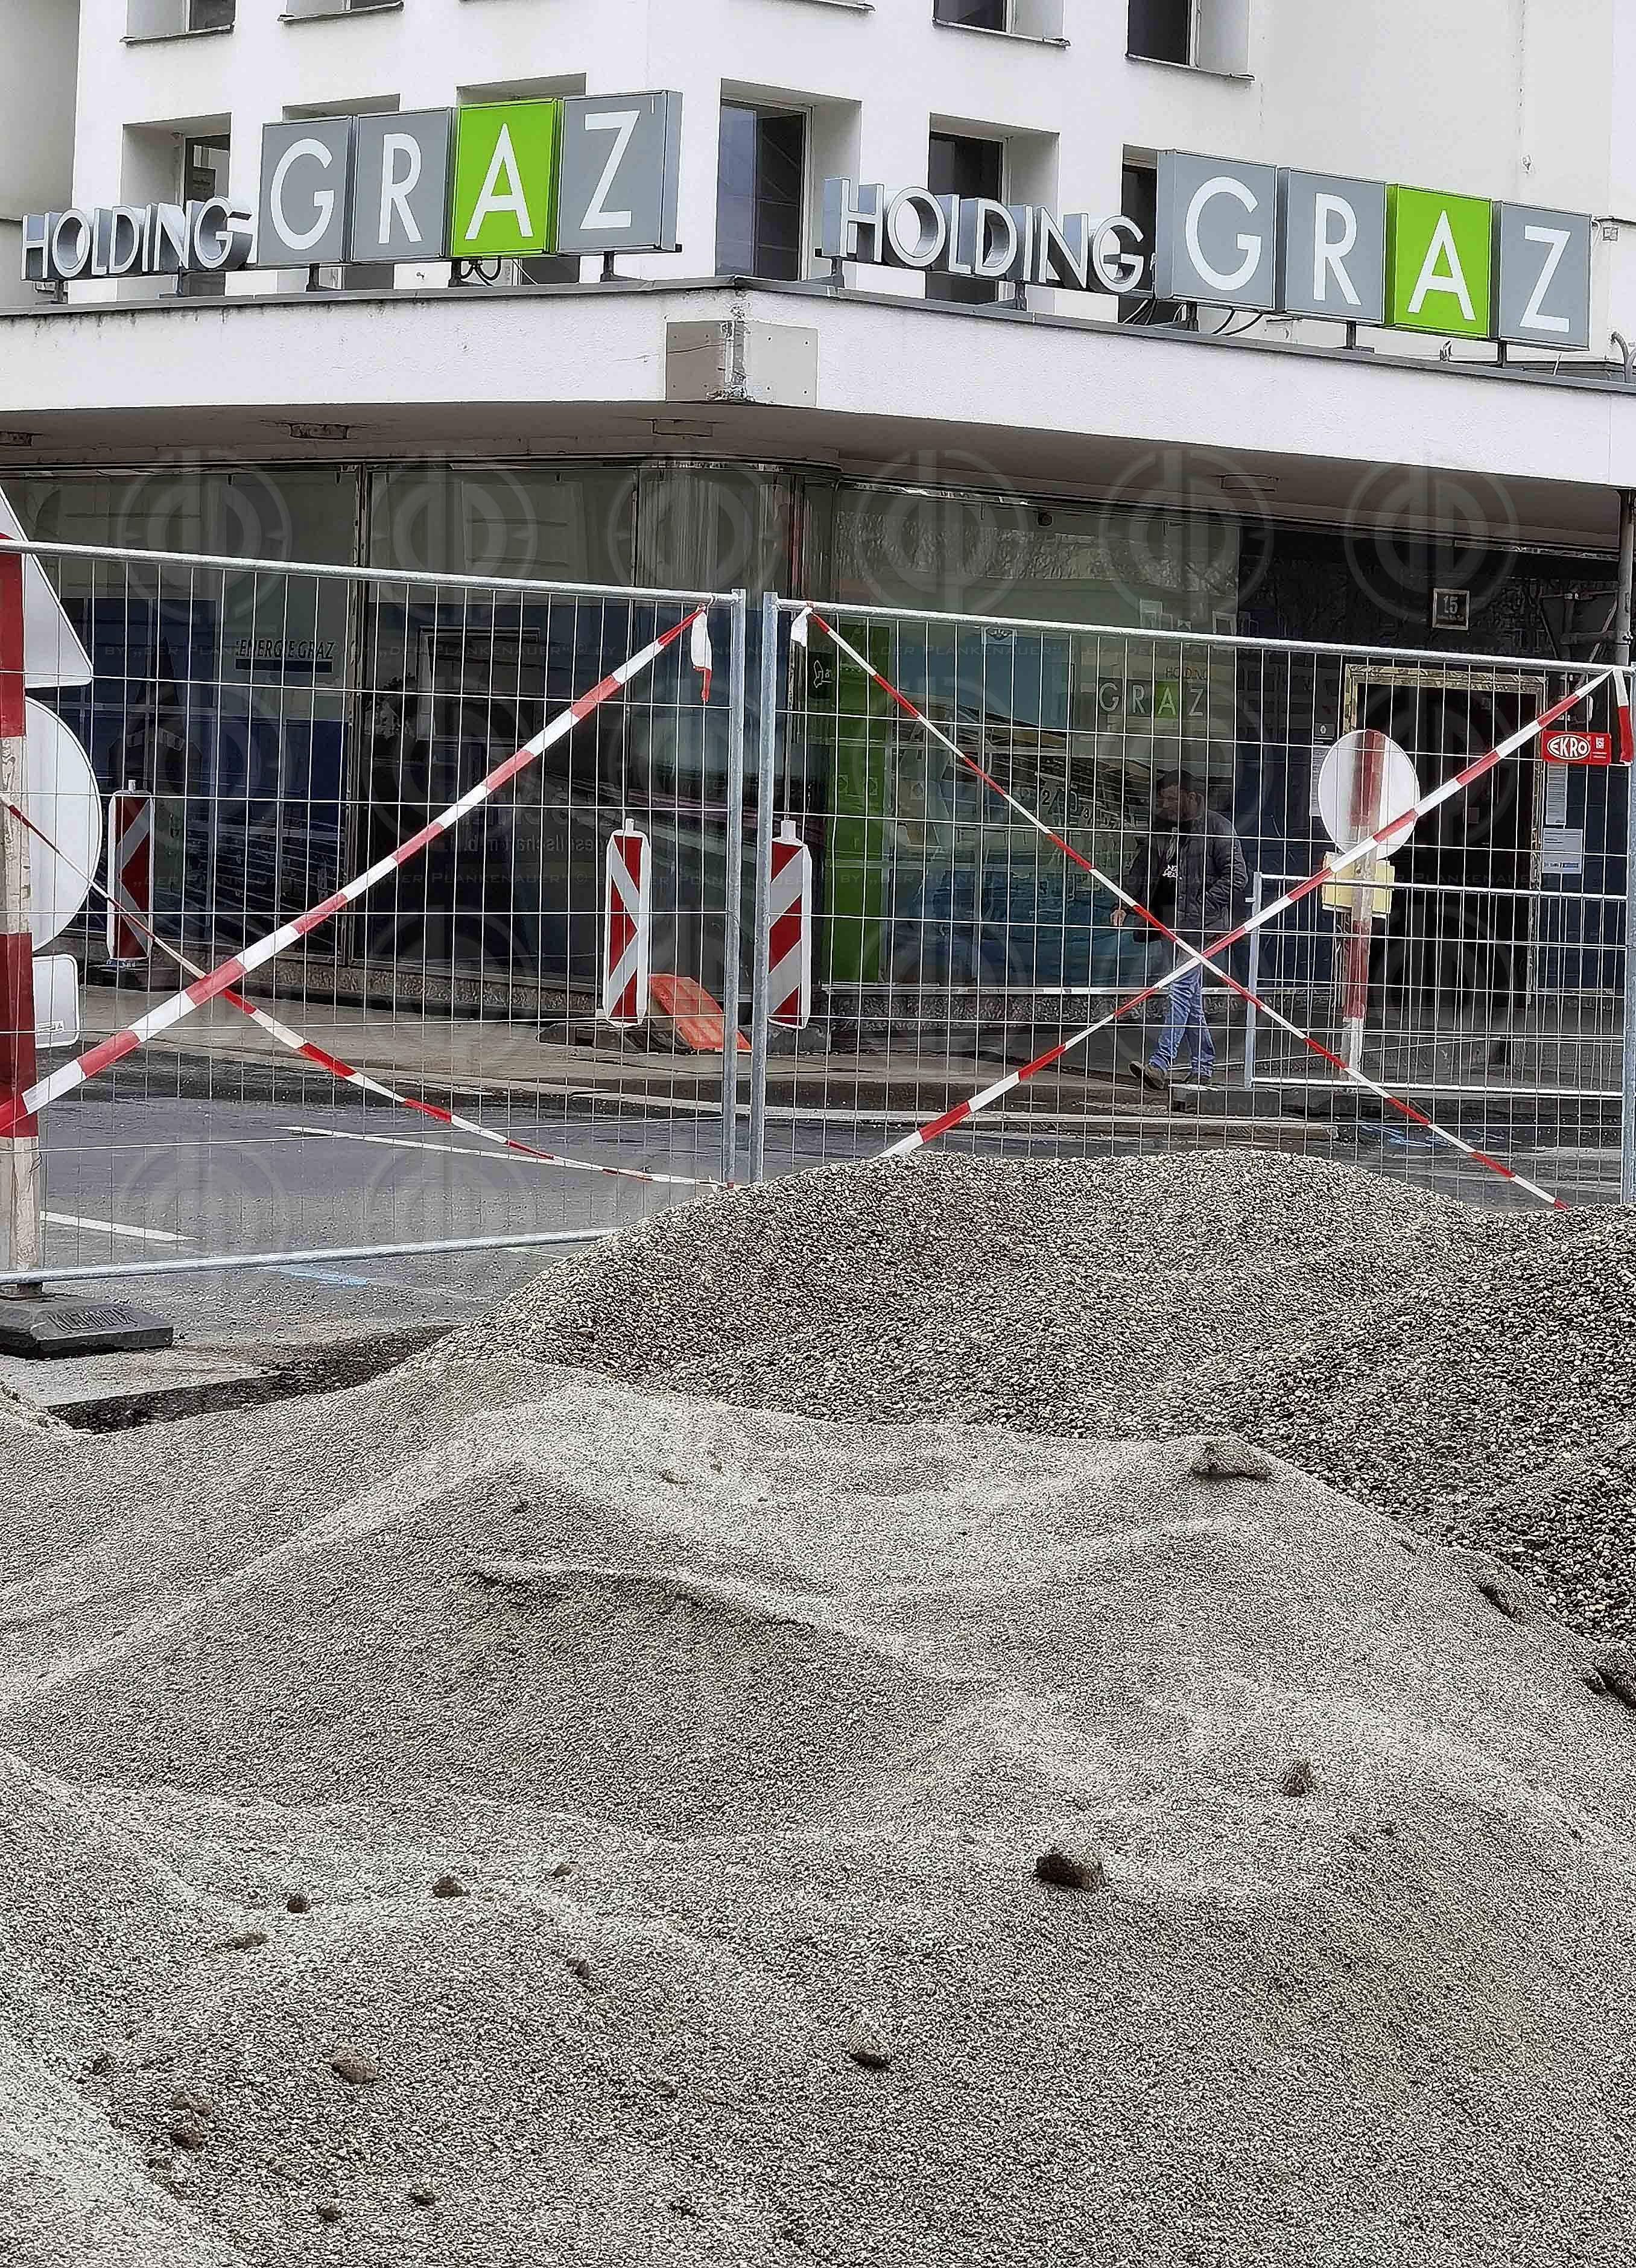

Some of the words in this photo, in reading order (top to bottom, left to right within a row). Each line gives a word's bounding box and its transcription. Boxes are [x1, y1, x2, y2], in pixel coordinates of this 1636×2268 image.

[22, 197, 252, 281] HOLDING
[270, 110, 641, 250] GRAZ
[824, 177, 1145, 294] HOLDING
[1184, 176, 1571, 334] GRAZ
[1442, 595, 1458, 614] 15
[1099, 682, 1204, 717] GRAZ
[1549, 736, 1588, 758] EKRO
